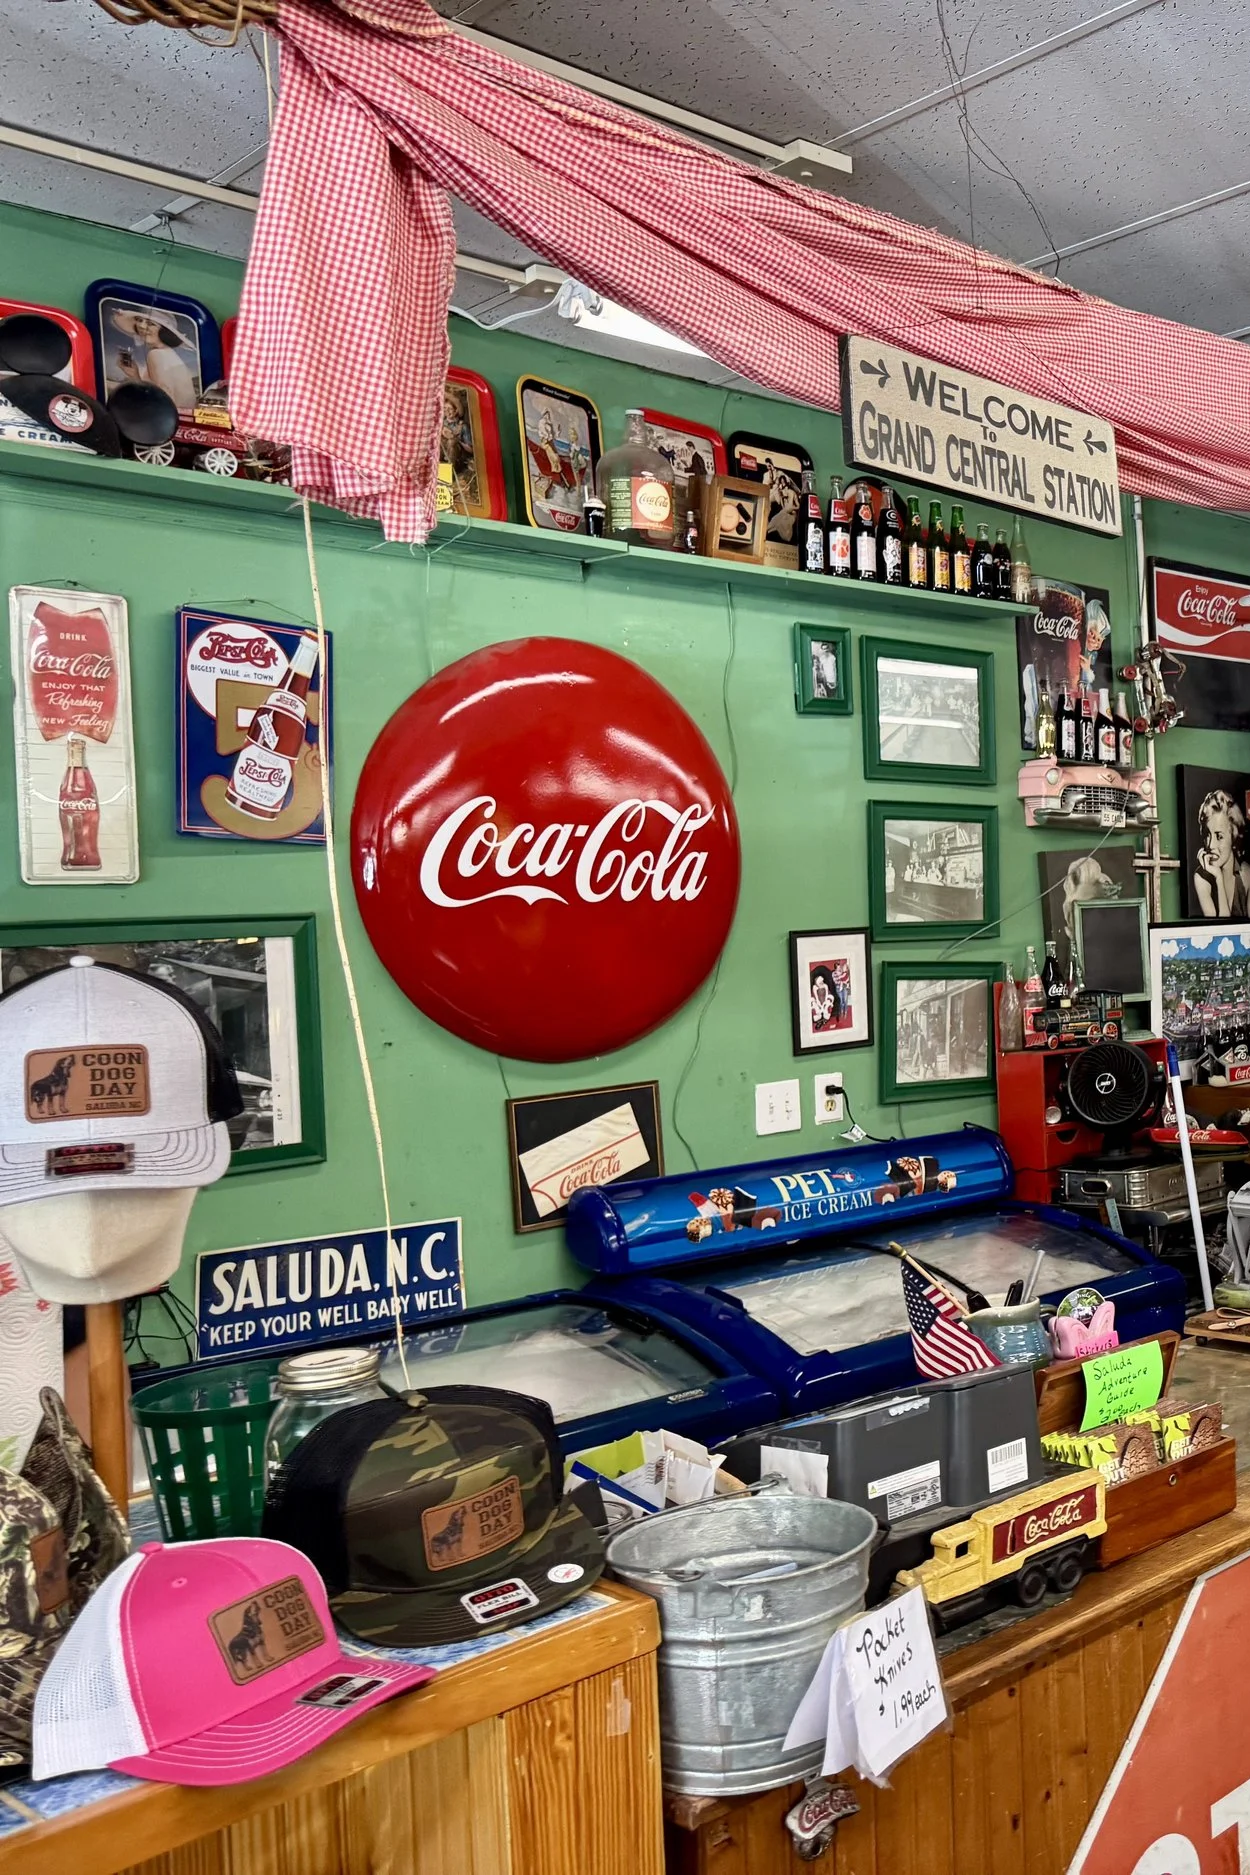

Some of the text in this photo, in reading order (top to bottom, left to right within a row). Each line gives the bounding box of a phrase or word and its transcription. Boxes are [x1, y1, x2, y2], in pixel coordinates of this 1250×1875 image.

[902, 361, 1074, 451] WELCOME
[981, 425, 997, 442] To
[859, 401, 1117, 525] GRAND CENTRAL STATION
[639, 493, 668, 508] Coca-Cola
[1195, 584, 1209, 595] Enjoy
[1177, 589, 1237, 626] Coca-Cola
[59, 632, 87, 642] DRINK
[1033, 611, 1079, 641] Coca-Cola
[29, 649, 113, 680] Coca-Cola
[190, 664, 217, 675] BIGGEST
[220, 667, 240, 678] VALUE
[253, 673, 274, 682] TOWN
[42, 681, 106, 692] ENJOY THAT
[45, 693, 104, 713] Refreshing
[42, 713, 110, 732] NEW Feeling
[59, 797, 98, 812] Coca-Cola
[419, 796, 716, 908] Coca-Cola
[82, 1052, 143, 1067] COON
[90, 1067, 136, 1082] DOG
[90, 1082, 136, 1097] DAY
[560, 1151, 620, 1199] Coca-Cola
[571, 1160, 594, 1173] DRINK
[771, 1168, 832, 1202] PET
[783, 1190, 873, 1223] ICE CREAM
[208, 1244, 381, 1316] SALUDA,
[261, 1311, 312, 1338] YOUR
[318, 1302, 362, 1327] WELL
[368, 1295, 410, 1318] BABY
[1093, 1358, 1132, 1381] Saluda
[1098, 1367, 1148, 1396] Adventure
[1106, 1387, 1135, 1404] Guide
[472, 1483, 515, 1514] COON
[479, 1500, 512, 1524] DOG
[480, 1510, 514, 1537] DAY
[1023, 1495, 1085, 1545] Coca-Cola
[263, 1584, 304, 1609] COON
[473, 1584, 514, 1602] OTTO
[477, 1592, 523, 1609] FLEX BILL
[275, 1599, 305, 1621] DOG
[281, 1612, 312, 1636] DAY
[856, 1608, 905, 1668] Pocket
[875, 1643, 913, 1694] Knives
